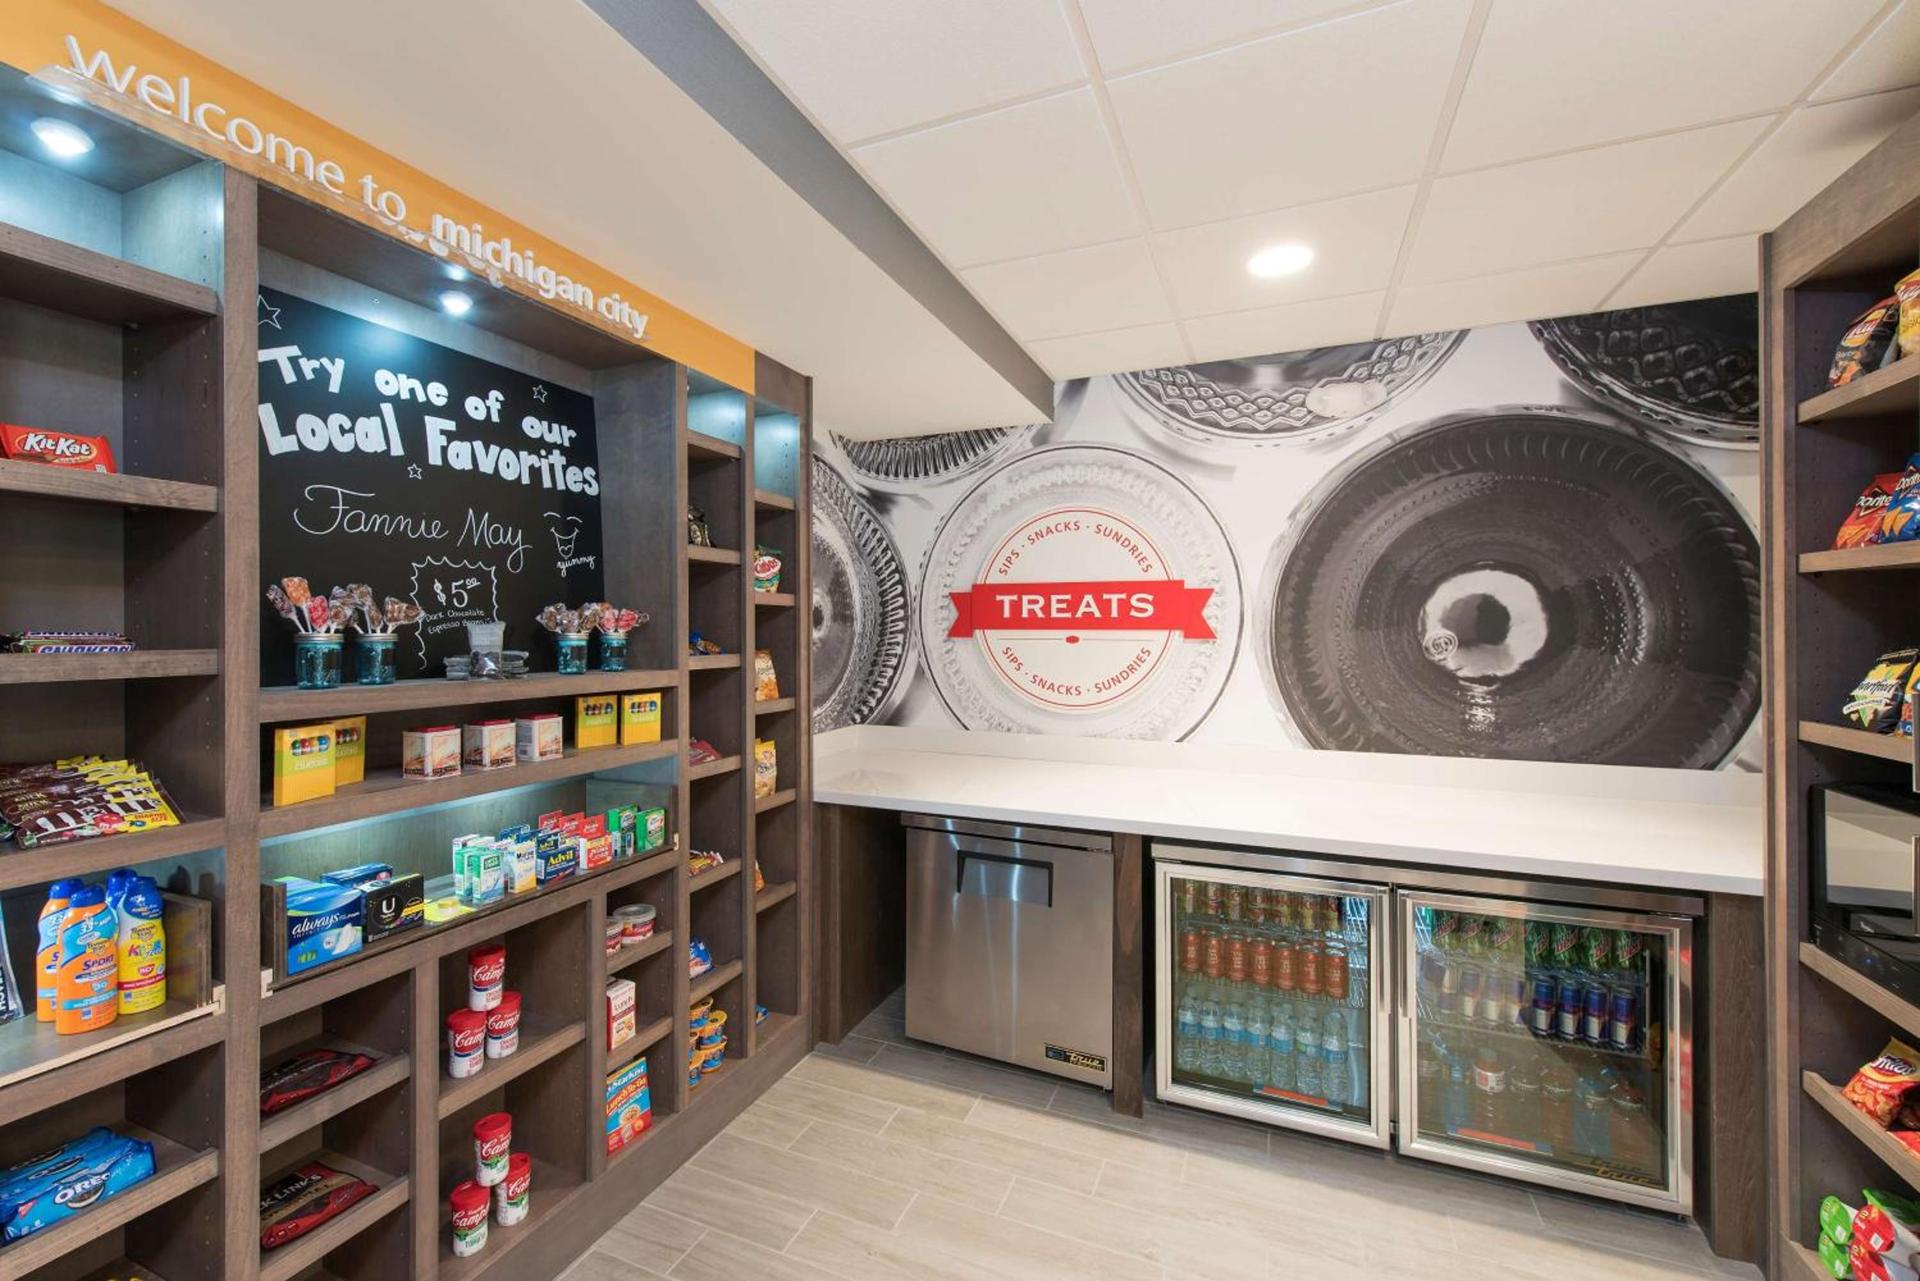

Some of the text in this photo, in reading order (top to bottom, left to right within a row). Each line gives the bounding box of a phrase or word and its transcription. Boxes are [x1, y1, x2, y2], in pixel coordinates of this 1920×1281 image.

[65, 35, 650, 338] welcome to michigan city
[257, 344, 577, 448] Try one of our
[258, 402, 600, 496] Local Favorites
[293, 484, 533, 573] Fannie May
[998, 521, 1153, 576] SIPS SNACKS SUNDRIES
[995, 593, 1155, 619] TREATS
[1003, 646, 1151, 696] SIPS SNACKS SUNDRIES
[549, 851, 573, 864] Advil
[292, 912, 340, 935] always
